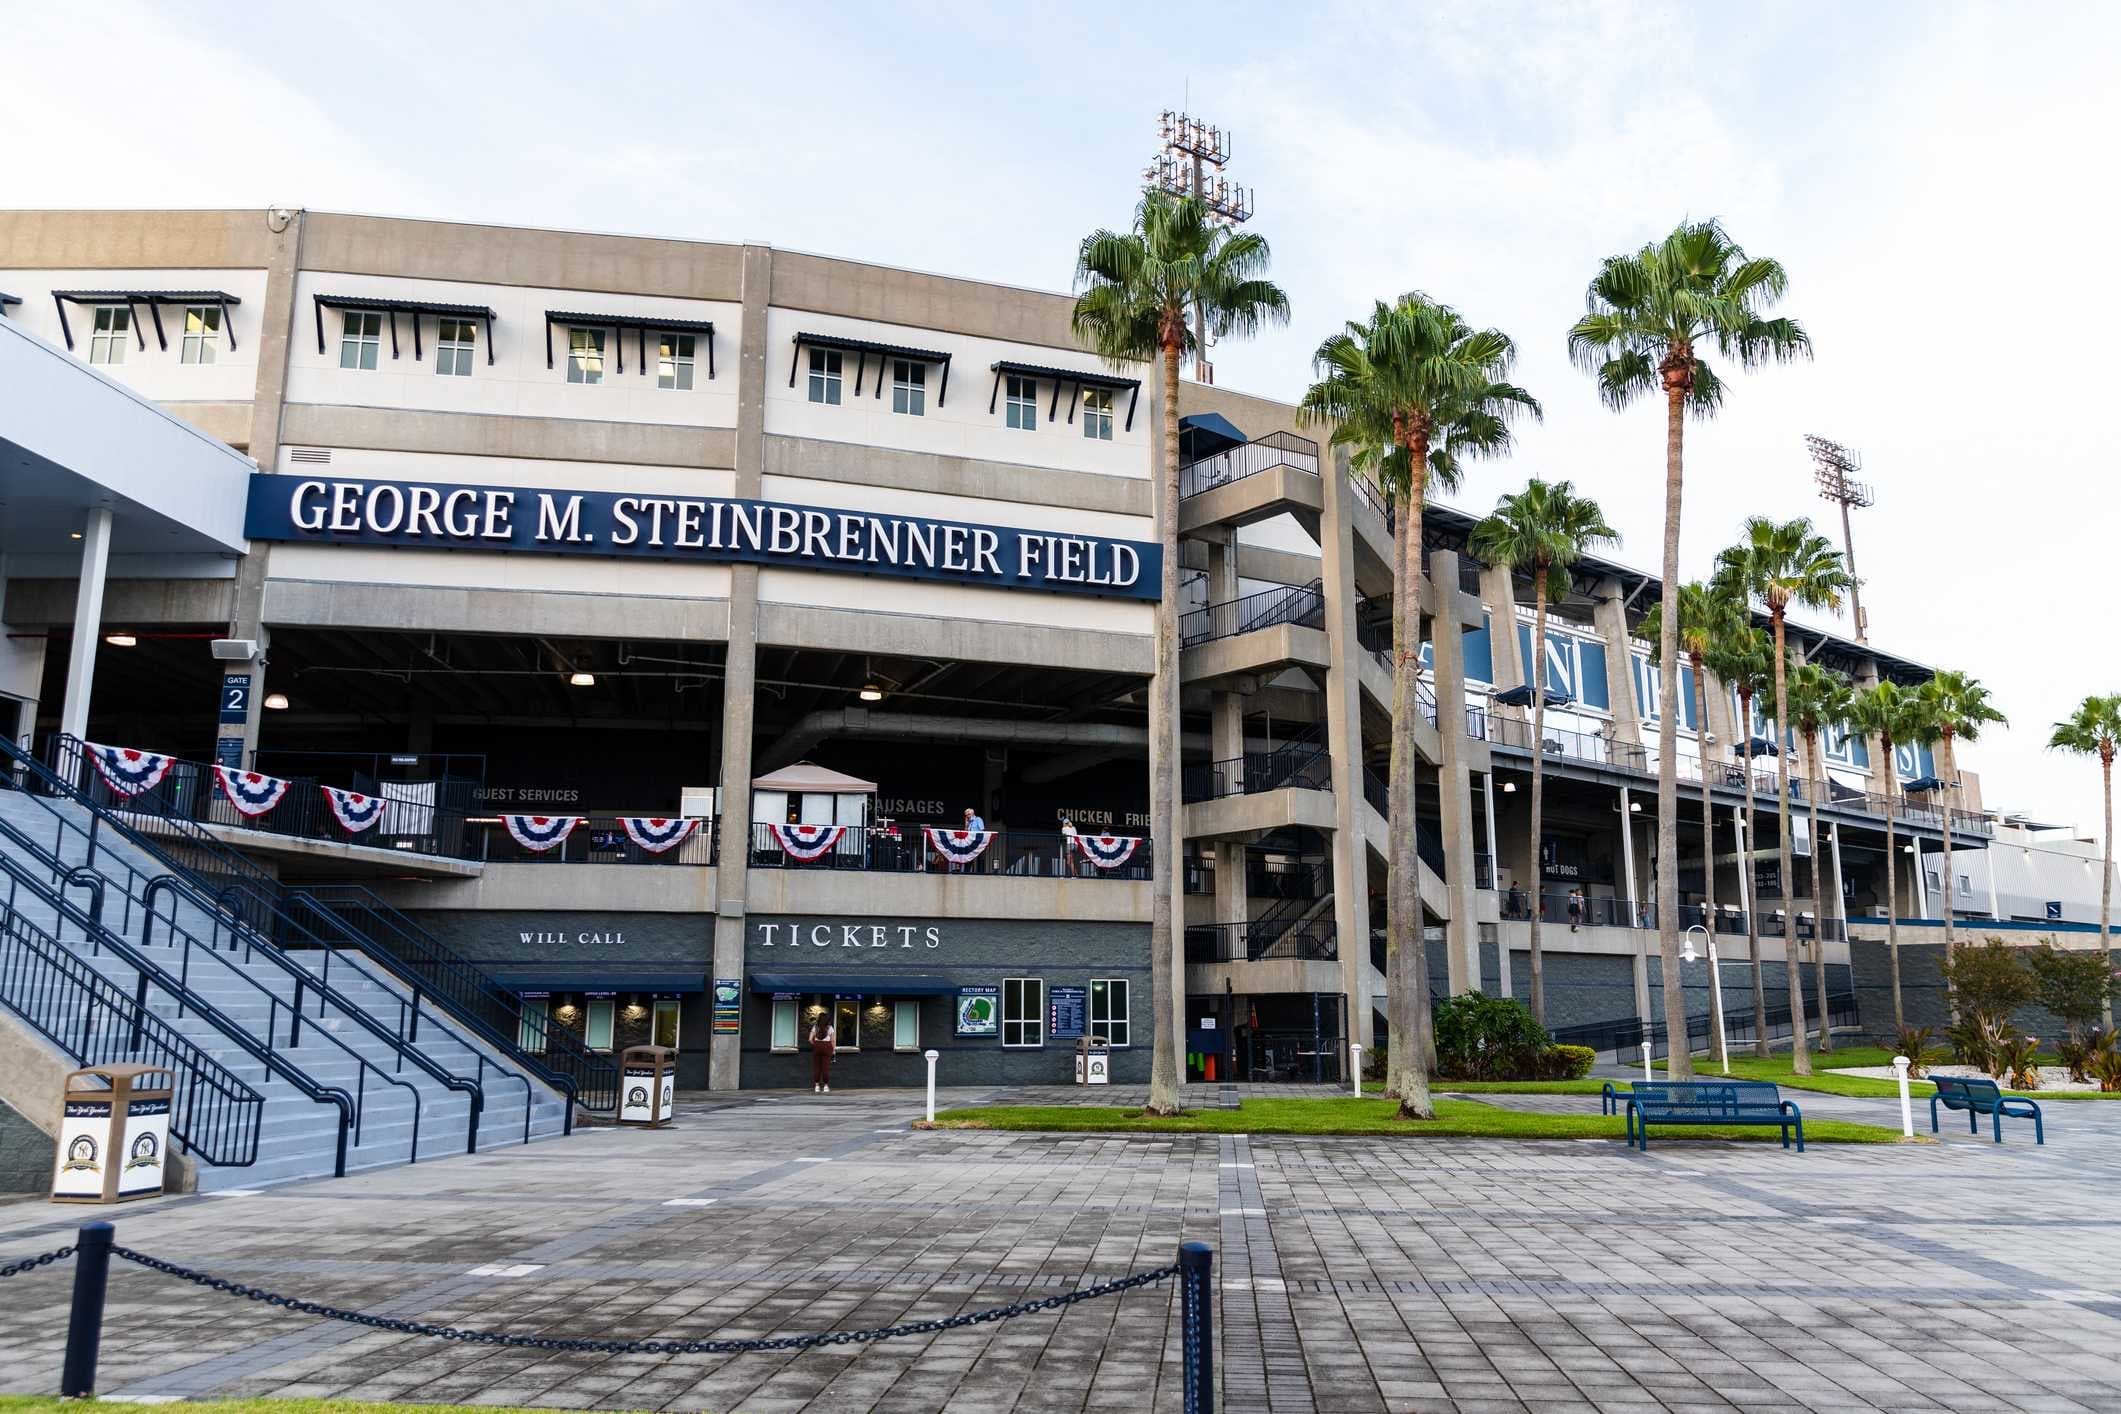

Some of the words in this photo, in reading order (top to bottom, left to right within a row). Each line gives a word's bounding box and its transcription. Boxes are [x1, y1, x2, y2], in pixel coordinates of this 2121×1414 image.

[290, 481, 514, 538] GEORGE
[535, 493, 593, 542] M.
[611, 497, 1002, 575] STEINBRENNER
[1017, 534, 1140, 587] FIELD
[228, 689, 243, 709] 2
[472, 788, 515, 800] GUEST
[519, 789, 579, 801] SERVICES
[866, 798, 945, 814] SAUSAGES
[1057, 808, 1113, 824] CHICKEN
[1125, 813, 1151, 826] FRIE
[1560, 865, 1578, 875] DOGS
[520, 932, 568, 943] WILL
[578, 932, 625, 944] CALL
[758, 924, 940, 948] TICKETS
